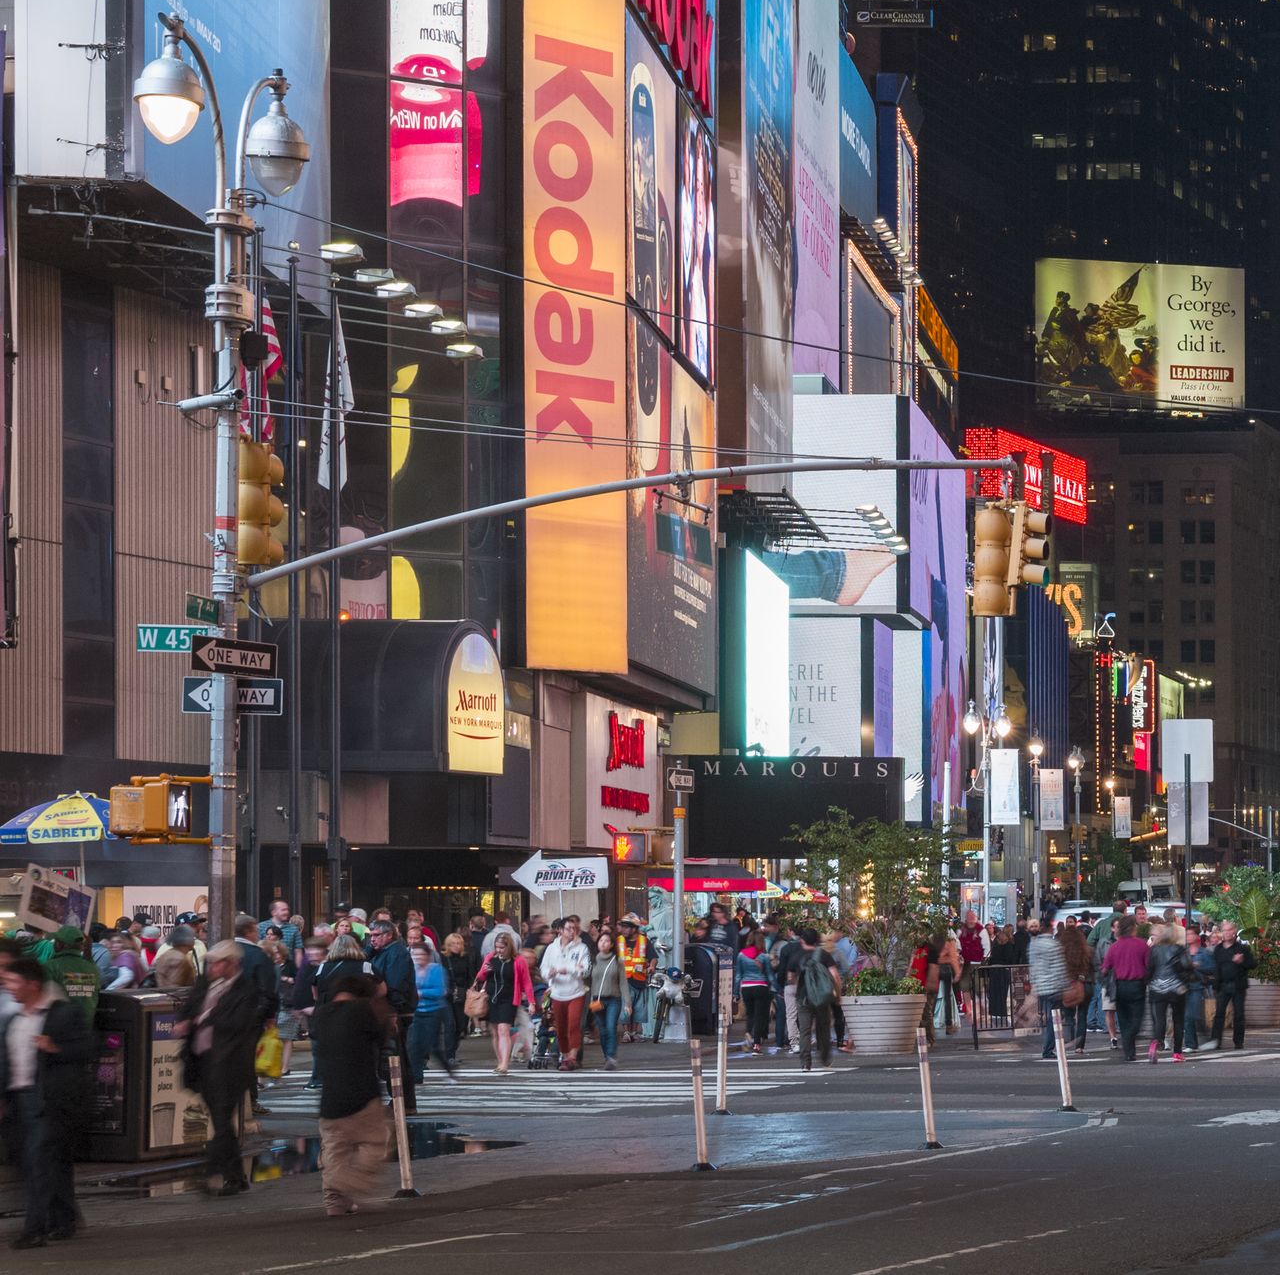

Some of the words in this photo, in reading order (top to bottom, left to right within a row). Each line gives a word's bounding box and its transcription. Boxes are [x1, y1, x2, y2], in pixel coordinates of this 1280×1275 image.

[533, 33, 617, 451] Kodak
[1191, 275, 1213, 297] By
[1167, 294, 1236, 317] George,
[1190, 319, 1214, 331] we
[1177, 333, 1205, 352] did
[1210, 336, 1226, 354] it.
[1171, 366, 1231, 381] LEADERSHIP
[1180, 381, 1197, 391] Pass
[1171, 394, 1207, 403] VALUES.COM
[1053, 474, 1084, 502] PLAZA
[138, 628, 158, 649] W
[165, 628, 191, 650] 45
[207, 648, 233, 664] ONE
[239, 652, 266, 667] WAY
[238, 687, 268, 704] WAY
[455, 689, 497, 713] Marriott
[806, 685, 838, 702] THE
[449, 716, 462, 726] NEW
[463, 717, 478, 728] YORK
[478, 719, 503, 731] MARQUIS
[702, 759, 889, 781] MARQUIS
[44, 808, 89, 821] SABRETT
[31, 826, 99, 839] SABRETT
[535, 870, 574, 883] PRIVATE
[572, 873, 596, 888] EYES
[153, 1055, 165, 1066] put
[158, 1081, 173, 1092] place
